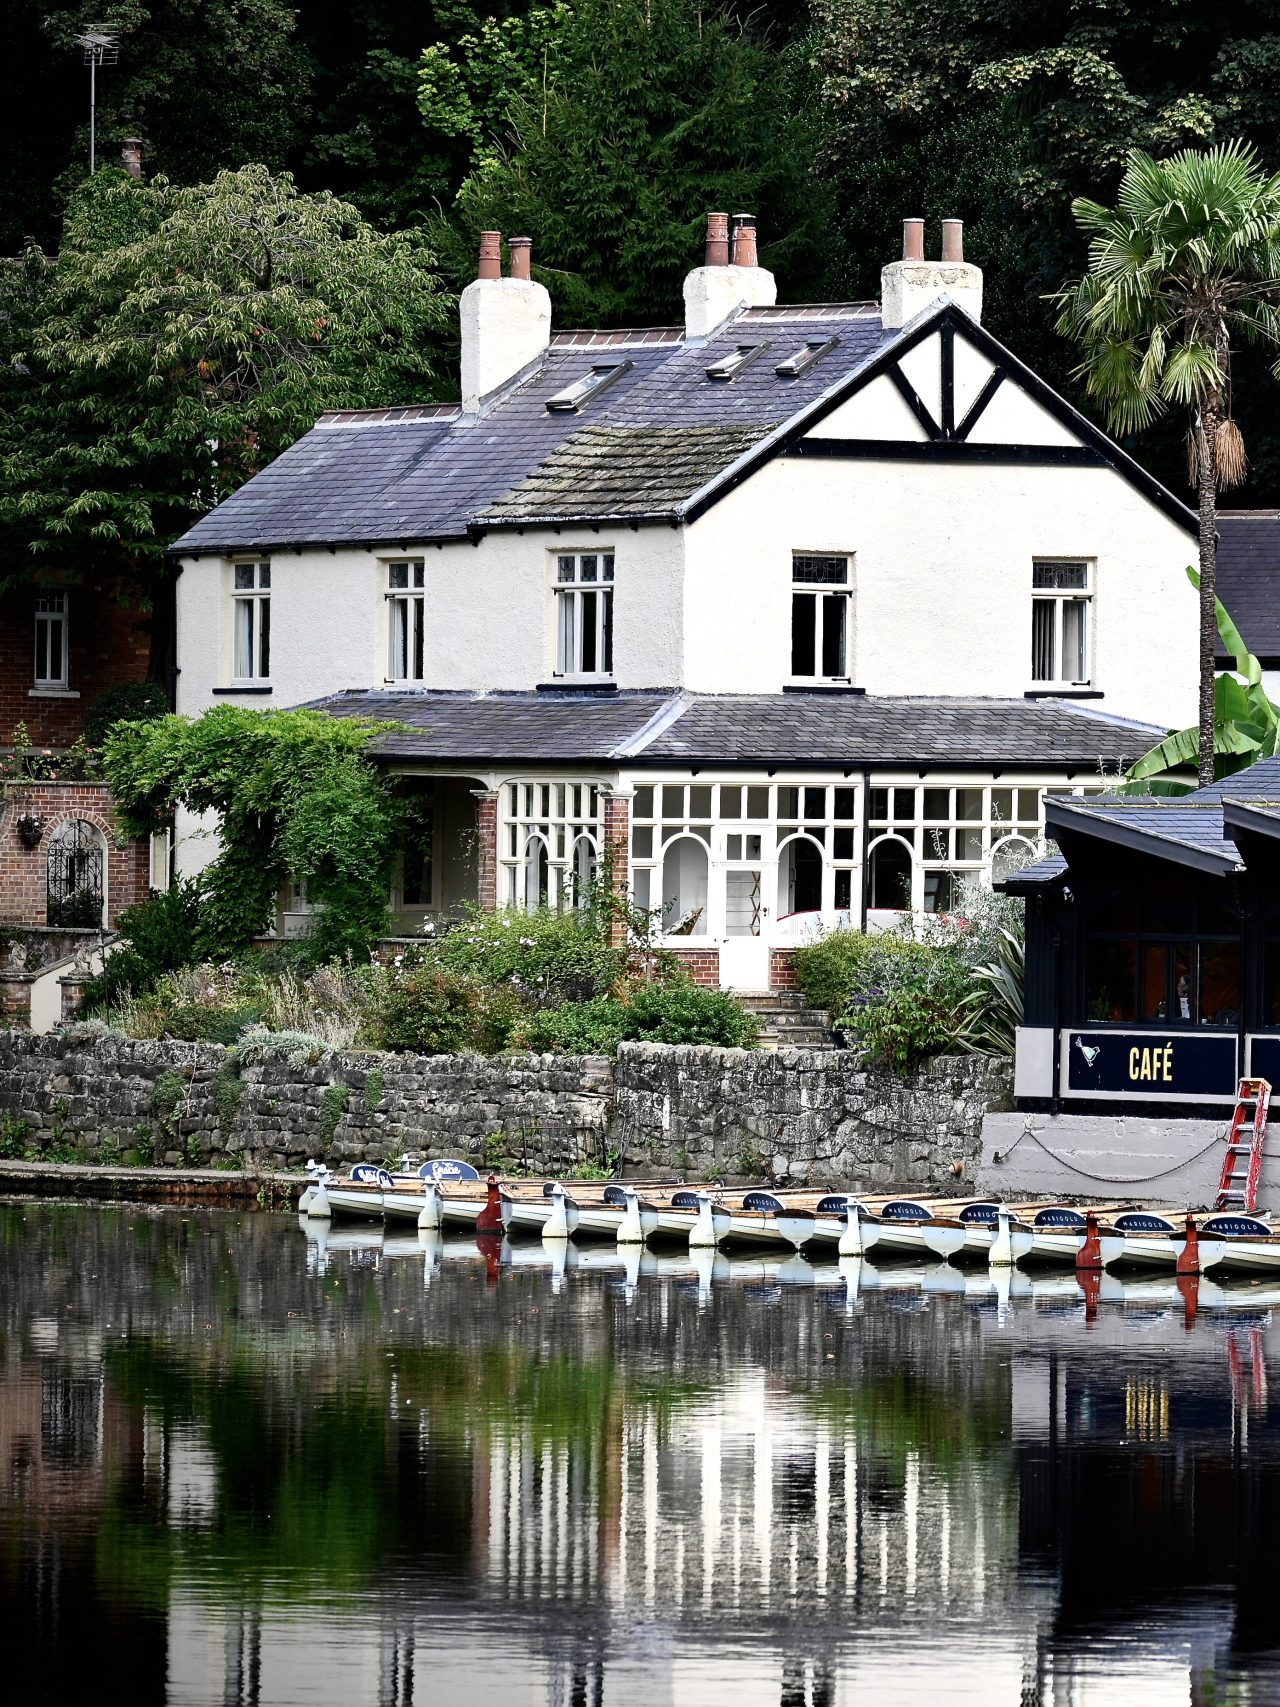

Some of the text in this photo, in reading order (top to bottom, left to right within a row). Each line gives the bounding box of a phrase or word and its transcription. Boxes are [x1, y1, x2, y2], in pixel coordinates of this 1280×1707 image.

[1128, 1042, 1174, 1081] CAFÉ
[888, 1207, 923, 1215] MARIGOLD
[1122, 1221, 1163, 1229] MARIGOLD
[1211, 1223, 1258, 1231] MARIGOLD
